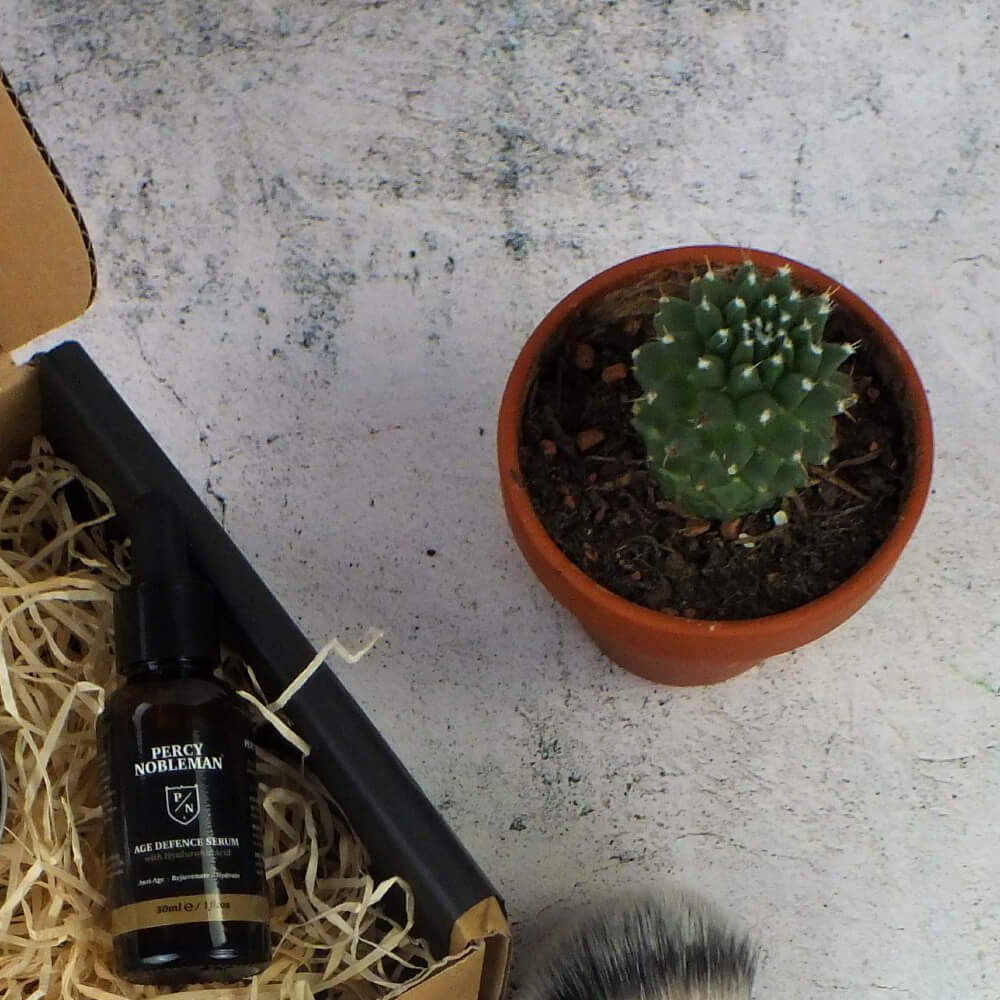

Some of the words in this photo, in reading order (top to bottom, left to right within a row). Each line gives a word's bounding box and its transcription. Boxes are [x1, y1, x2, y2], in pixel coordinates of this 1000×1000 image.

[151, 742, 204, 760] PERCY
[134, 756, 223, 777] NOBLEMAN
[134, 842, 153, 855] AGE
[154, 838, 204, 851] DEFENCE
[205, 837, 240, 847] SERUM
